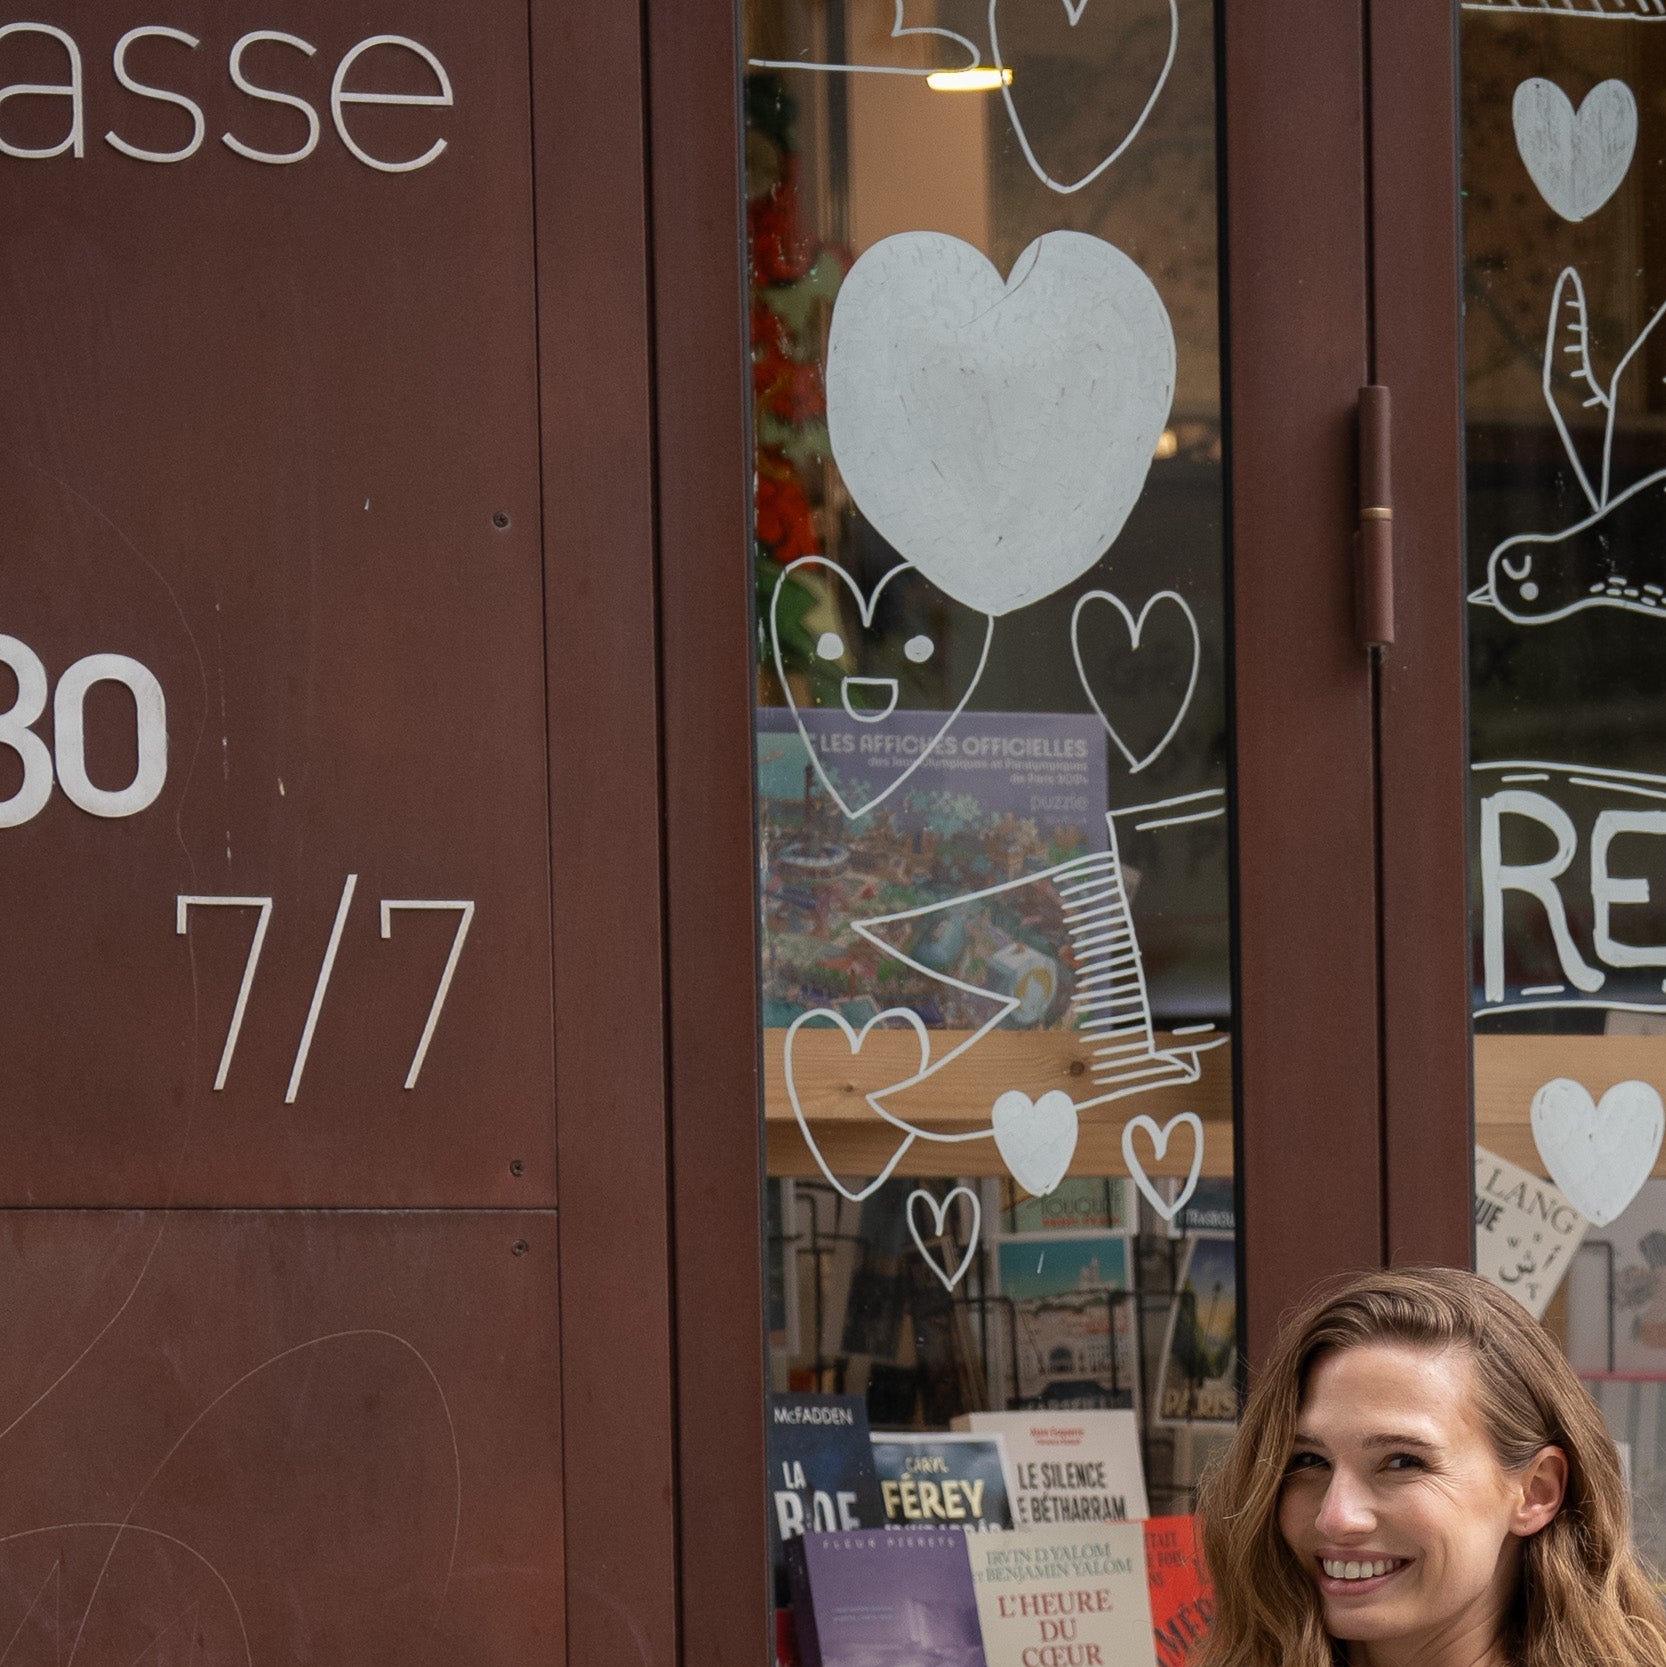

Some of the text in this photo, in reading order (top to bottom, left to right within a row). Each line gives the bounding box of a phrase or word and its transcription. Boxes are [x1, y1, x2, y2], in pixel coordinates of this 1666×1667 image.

[820, 734, 1088, 759] LES AFFICHES OFFICIELLES
[175, 873, 476, 1105] 7/7
[1485, 1167, 1579, 1235] LANG
[774, 1406, 855, 1426] McFADDEN
[782, 1460, 807, 1490] LA
[1016, 1461, 1107, 1491] LE SILENCE
[881, 1471, 984, 1520] FÉREY
[1031, 1492, 1127, 1523] BÉTHARRAM
[1049, 1543, 1112, 1562] YALOM
[986, 1562, 1070, 1585] BENJAMIN
[1072, 1557, 1133, 1577] YALOM
[998, 1588, 1113, 1619] L'HEURE
[1040, 1618, 1077, 1643] DU
